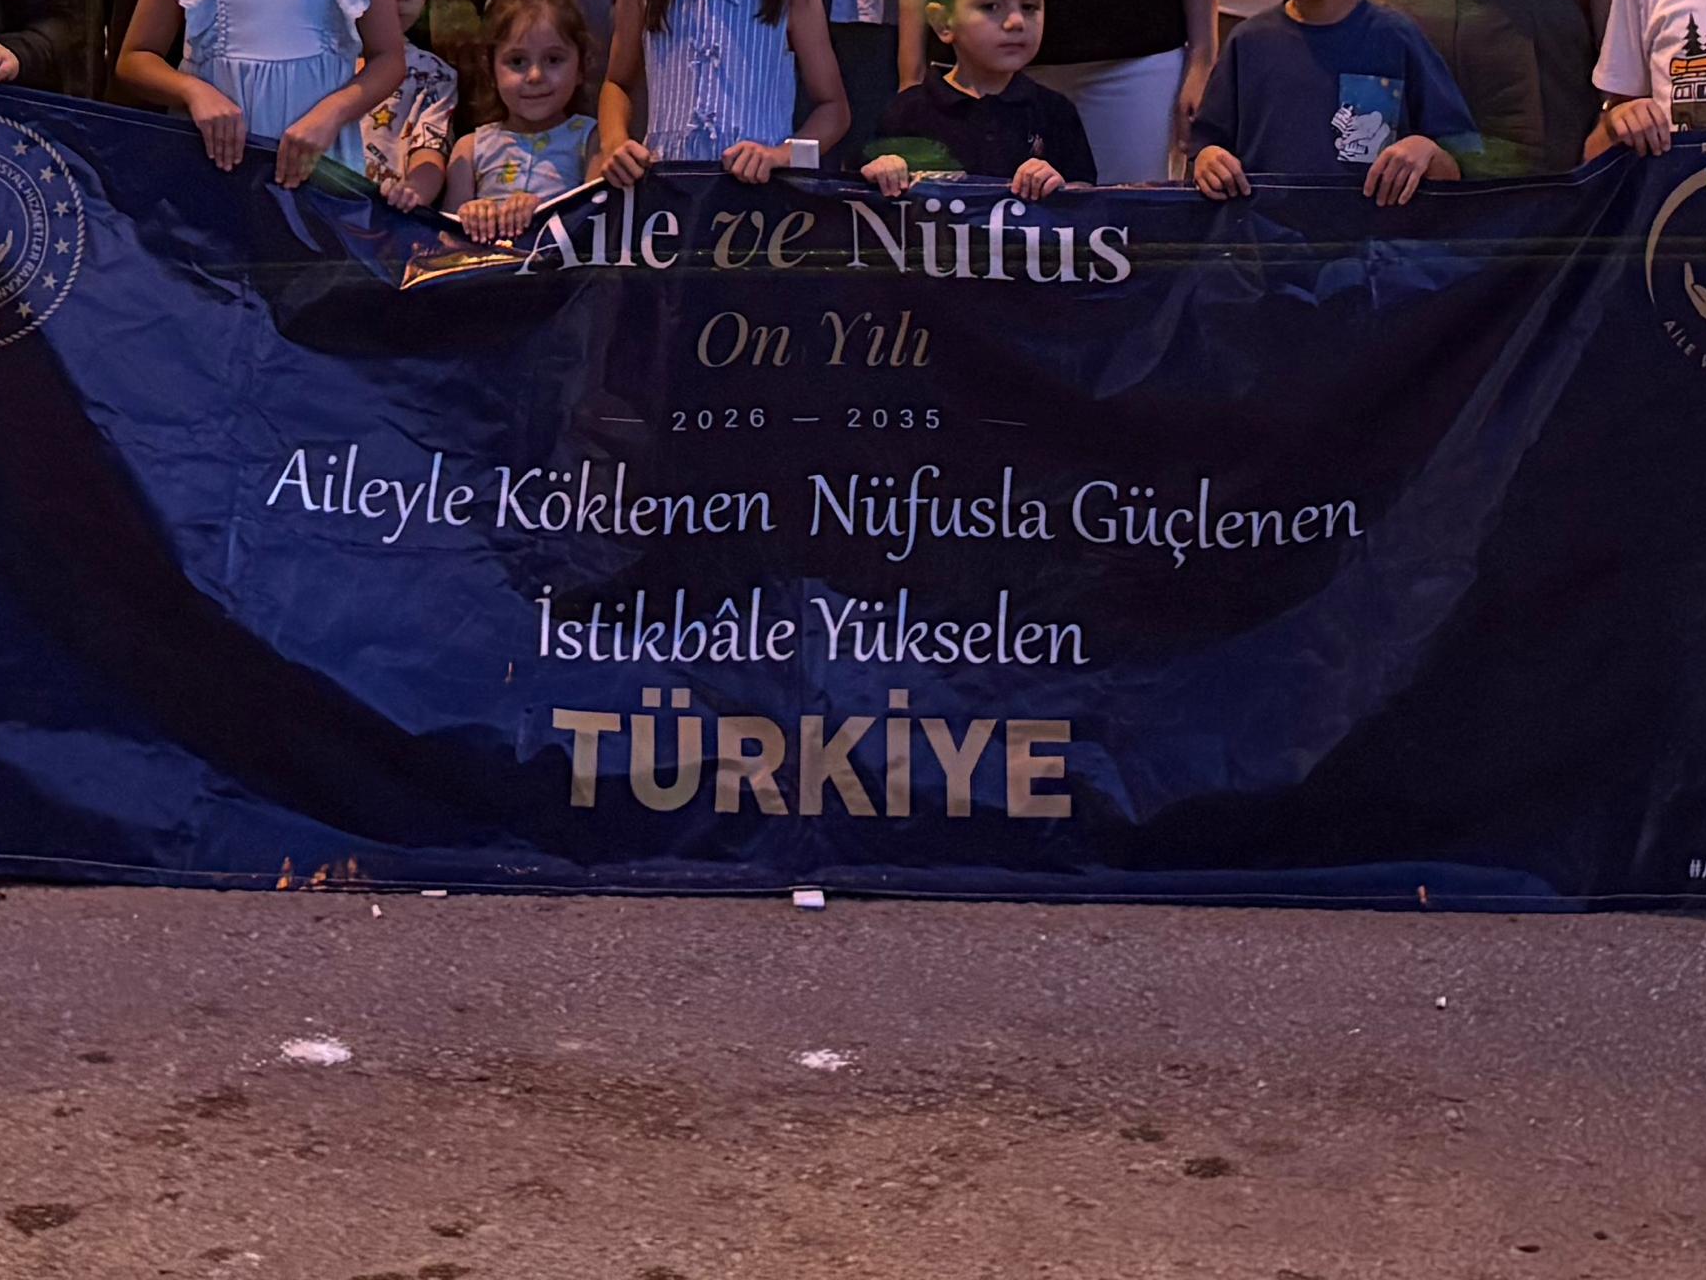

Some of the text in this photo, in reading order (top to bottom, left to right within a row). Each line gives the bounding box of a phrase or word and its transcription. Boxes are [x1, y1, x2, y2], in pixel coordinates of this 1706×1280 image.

[514, 185, 1132, 283] Aile ve Nüfus
[696, 310, 931, 368] On Yılı
[671, 407, 766, 432] 2026
[846, 408, 940, 430] 2035
[266, 444, 1365, 568] Aileyle Köklenen Nüfusla Güçlenen
[535, 584, 1091, 664] İstikbâle Yükselen
[551, 687, 1073, 818] TÜRKİYE
